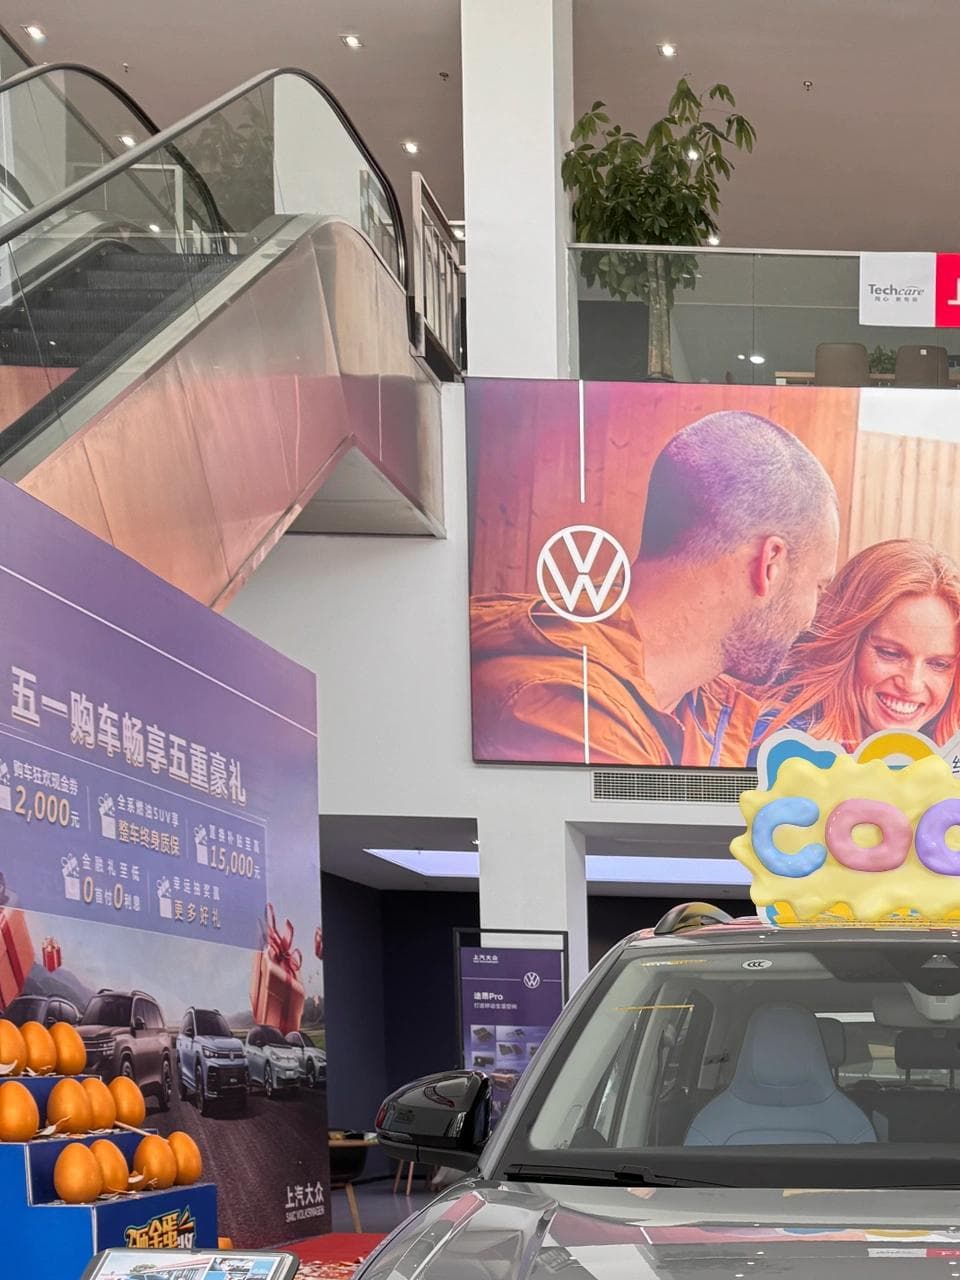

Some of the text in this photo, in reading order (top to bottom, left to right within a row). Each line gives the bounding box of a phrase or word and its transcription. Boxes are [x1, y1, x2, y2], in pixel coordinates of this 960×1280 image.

[868, 283, 925, 296] Techcare
[11, 665, 247, 807] 五一购车畅享五重豪礼
[15, 784, 80, 828] 2,000元
[118, 819, 181, 856] 整车终身质保
[210, 844, 261, 880] 15,000元
[174, 900, 221, 928] 更多好礼
[285, 1181, 325, 1208] 上汽大众
